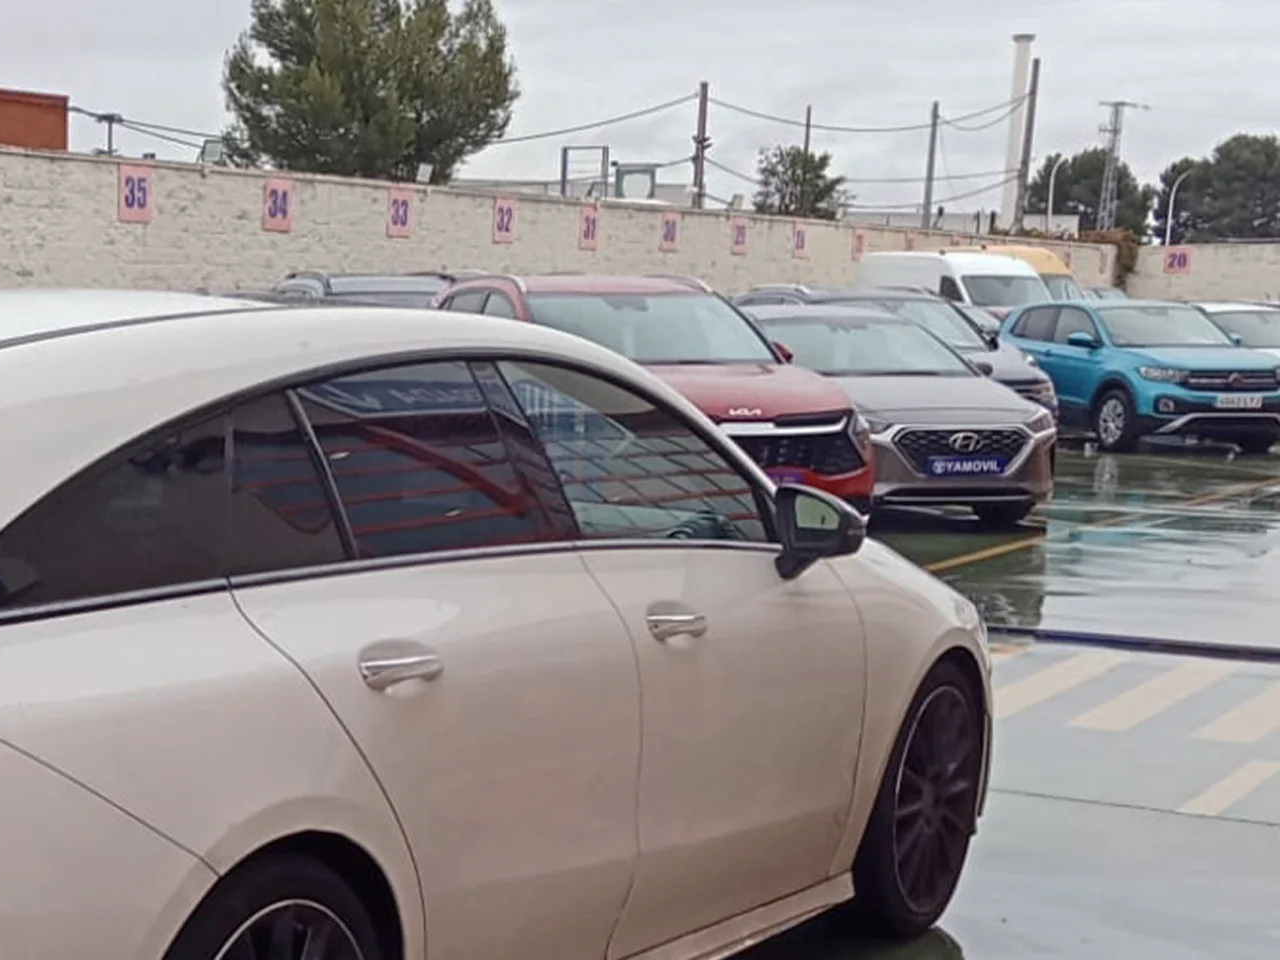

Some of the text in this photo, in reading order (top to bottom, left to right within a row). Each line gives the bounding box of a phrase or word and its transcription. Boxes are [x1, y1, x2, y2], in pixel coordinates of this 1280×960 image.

[124, 176, 148, 210] 35
[268, 188, 289, 220] 34
[391, 198, 410, 227] 33
[496, 206, 513, 233] 32
[583, 215, 597, 241] 31
[1167, 252, 1187, 269] 20
[946, 460, 1001, 473] YAMOVIL
